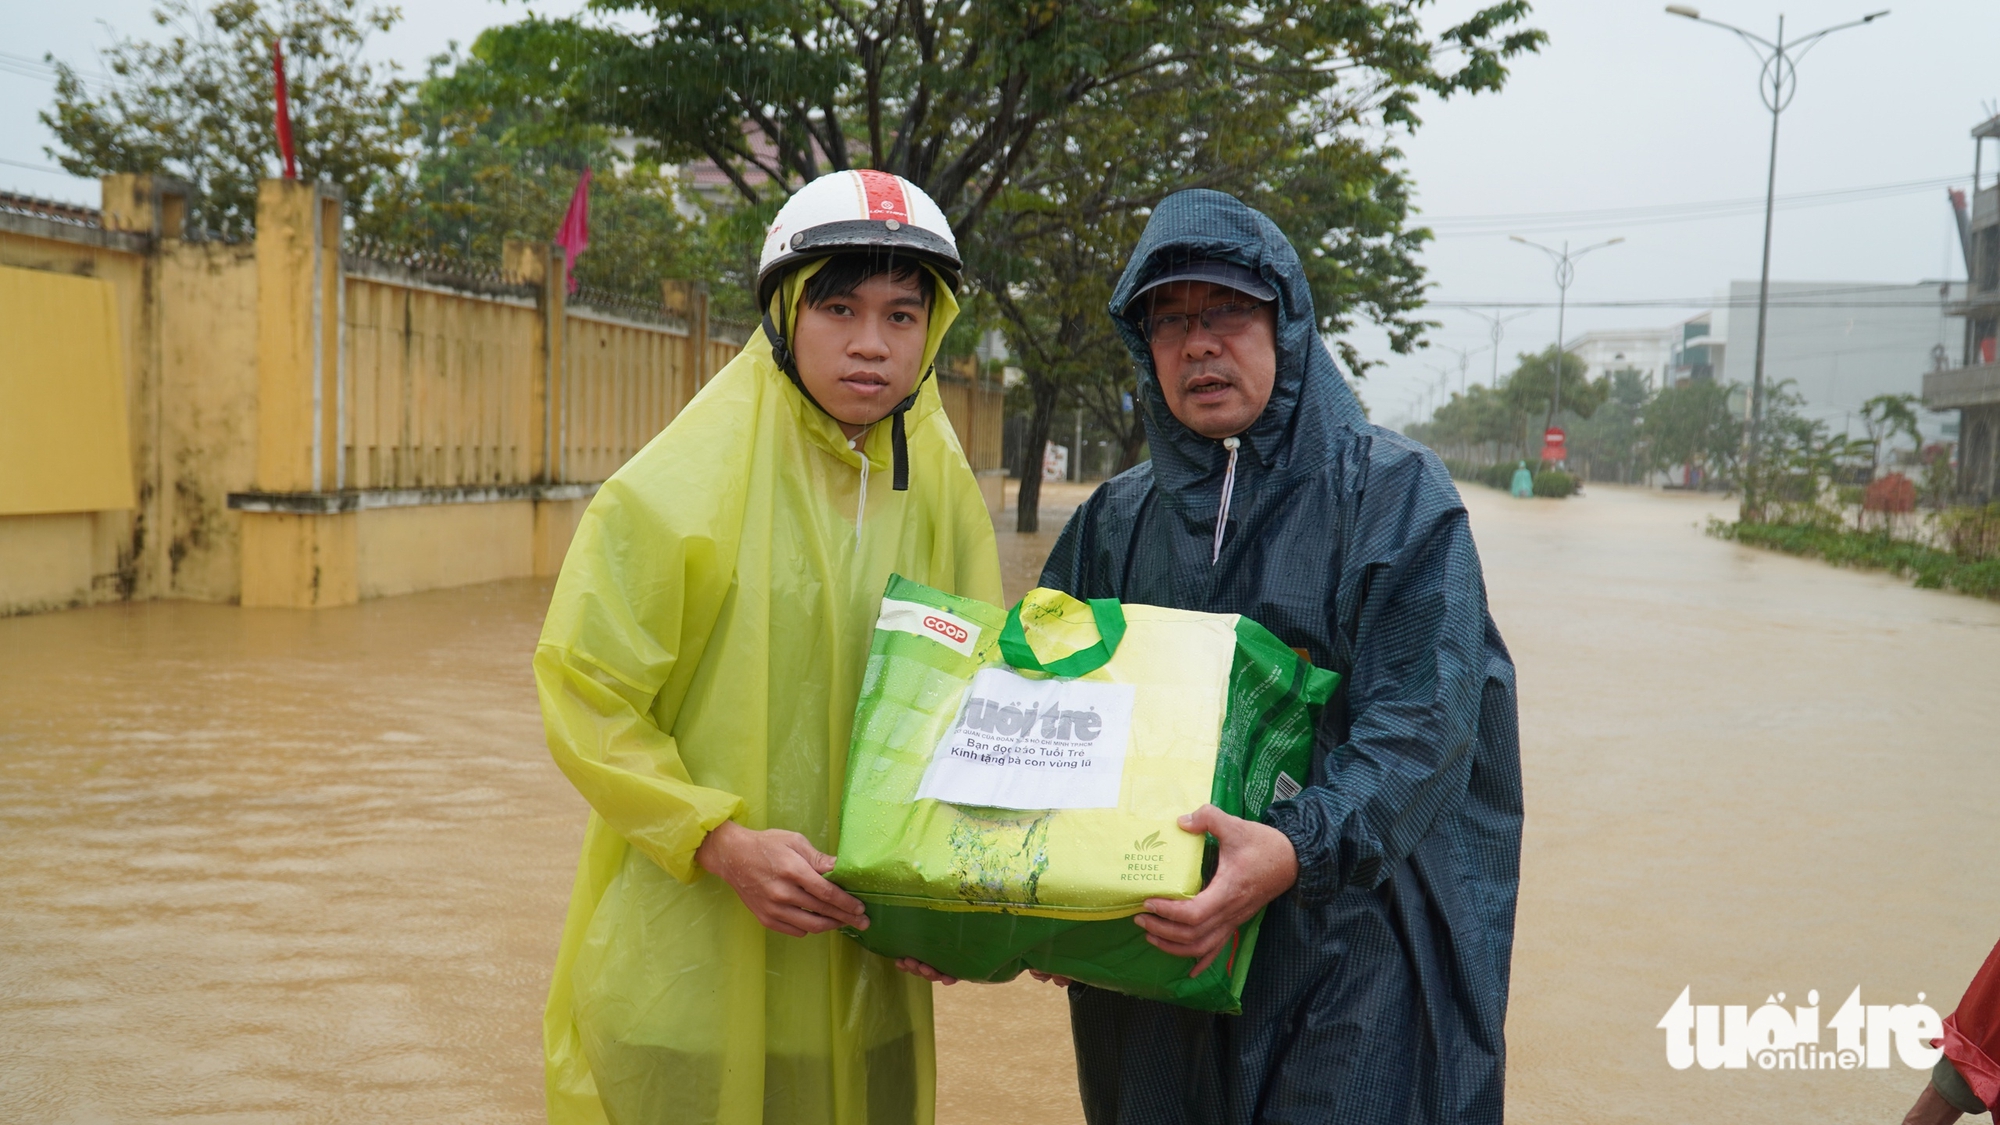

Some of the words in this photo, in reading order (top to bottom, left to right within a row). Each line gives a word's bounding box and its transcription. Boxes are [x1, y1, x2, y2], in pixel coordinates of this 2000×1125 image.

[925, 617, 967, 640] COOP
[1040, 701, 1103, 742] trẻ
[962, 729, 981, 737] QUAN
[966, 738, 989, 751] Bạn
[992, 744, 1013, 755] đọc
[1040, 747, 1064, 757] Tuổi
[1068, 749, 1085, 757] Trẻ
[950, 747, 978, 760] Kính
[980, 753, 1005, 766] tặng
[1024, 759, 1046, 767] con
[1049, 760, 1078, 769] vùng
[1081, 759, 1092, 768] lũ
[1124, 853, 1165, 862] REDUCE
[1127, 863, 1160, 871] REUSE
[1120, 873, 1165, 881] RECYCLE
